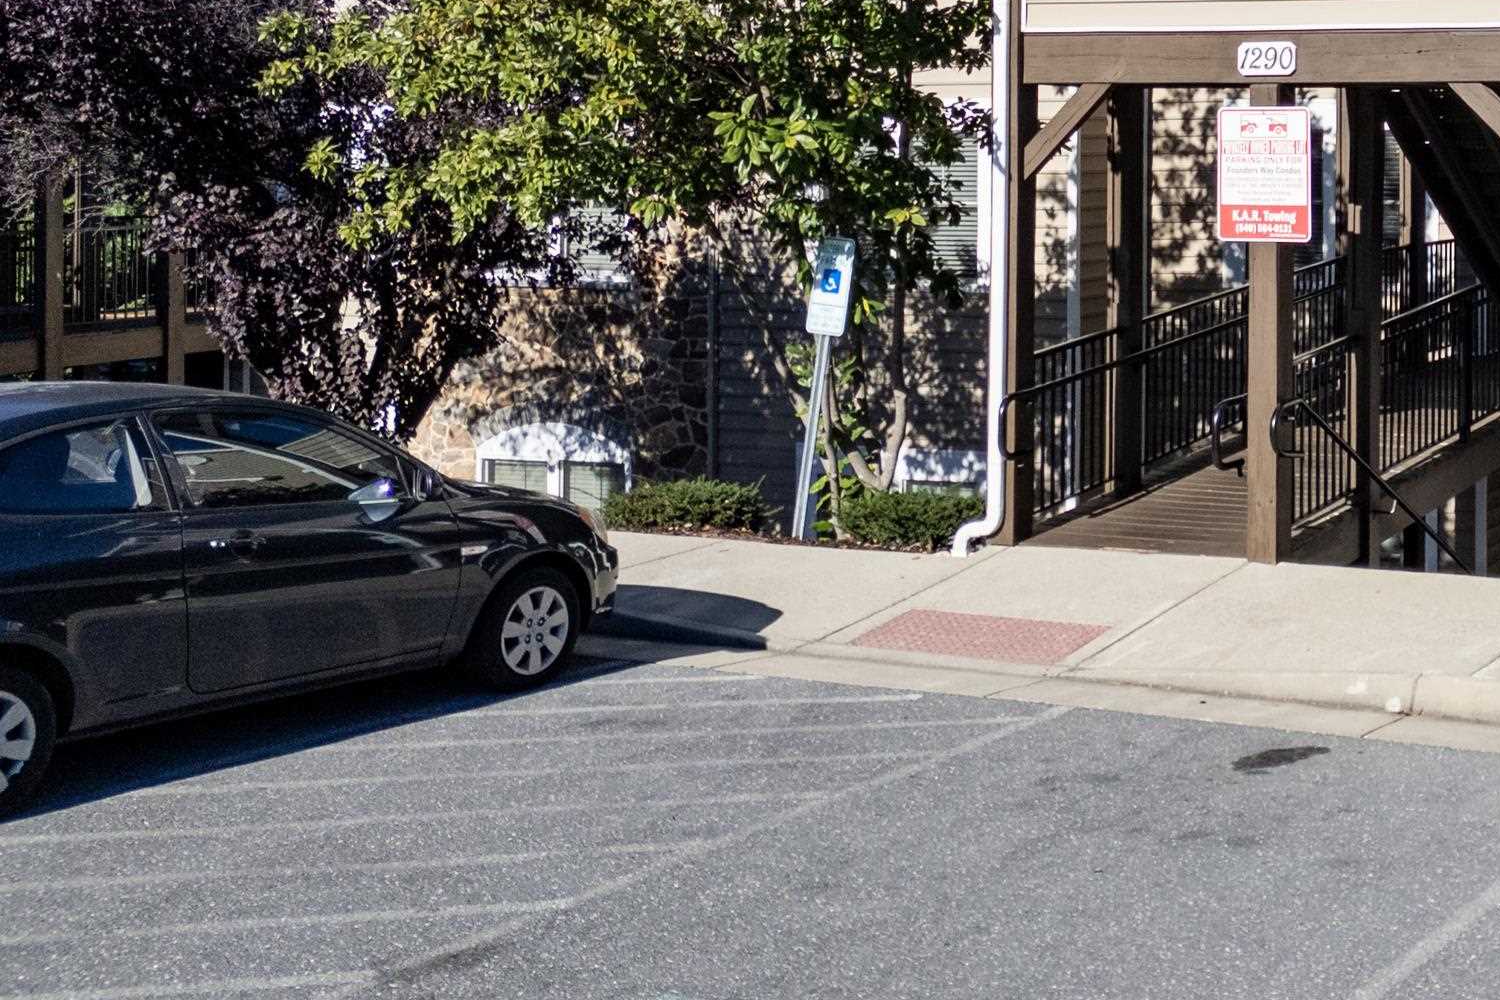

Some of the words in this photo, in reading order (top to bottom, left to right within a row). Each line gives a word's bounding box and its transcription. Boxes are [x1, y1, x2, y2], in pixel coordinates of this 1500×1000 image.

[1241, 46, 1293, 70] 1290
[1232, 209, 1261, 221] K.A.R.
[1263, 209, 1296, 224] Towing
